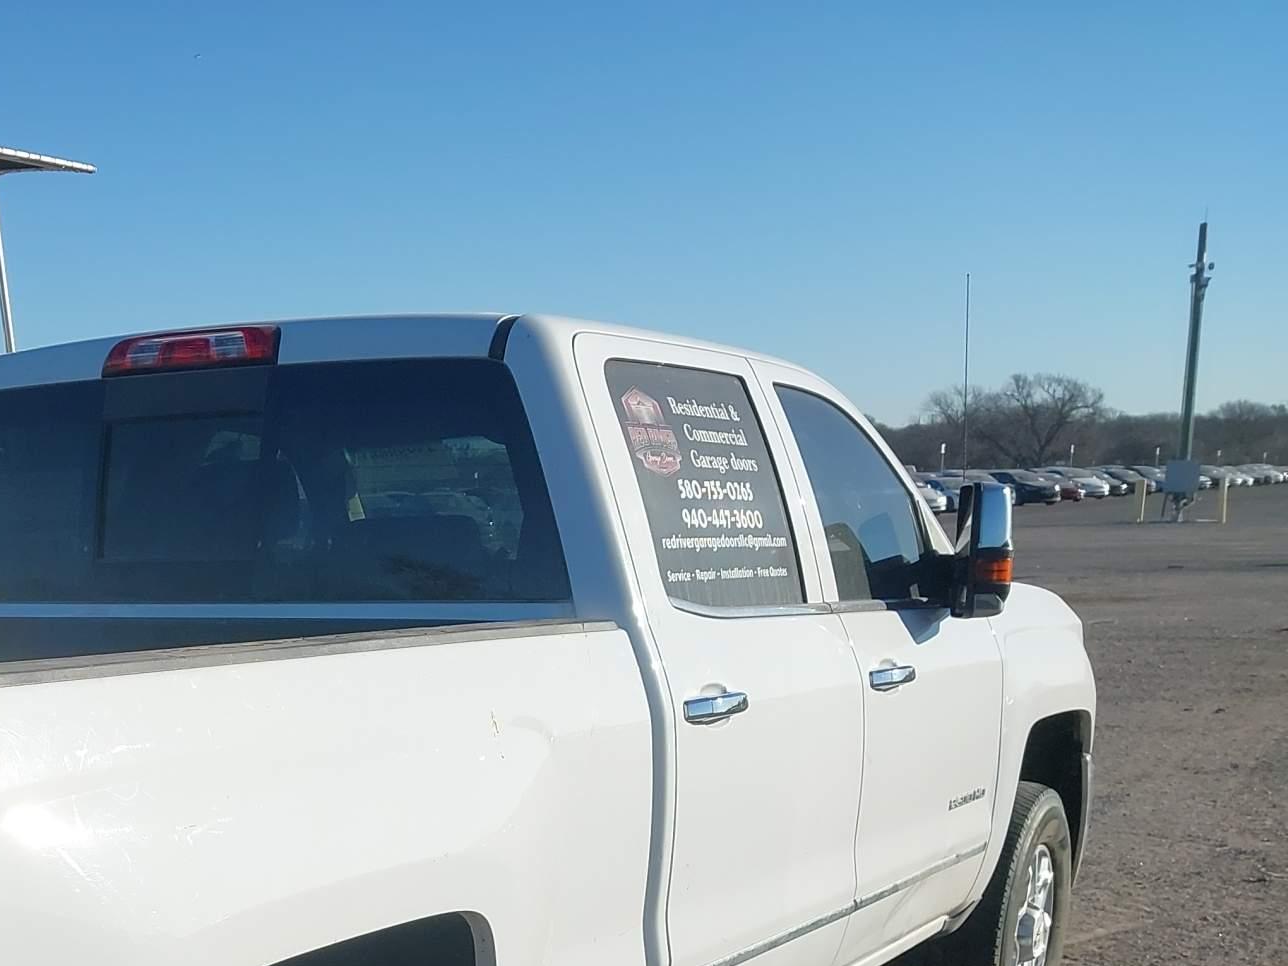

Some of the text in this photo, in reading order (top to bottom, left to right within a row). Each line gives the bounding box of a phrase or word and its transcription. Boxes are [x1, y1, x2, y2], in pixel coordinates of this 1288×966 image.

[667, 397, 740, 422] Residential &
[683, 424, 748, 446] Commercial
[690, 449, 758, 474] Garage doors
[677, 479, 753, 501] 580-755-0265
[682, 508, 763, 529] 940-447-3600
[667, 569, 691, 582] Service
[696, 567, 716, 582] Repair
[721, 566, 753, 579] Installation
